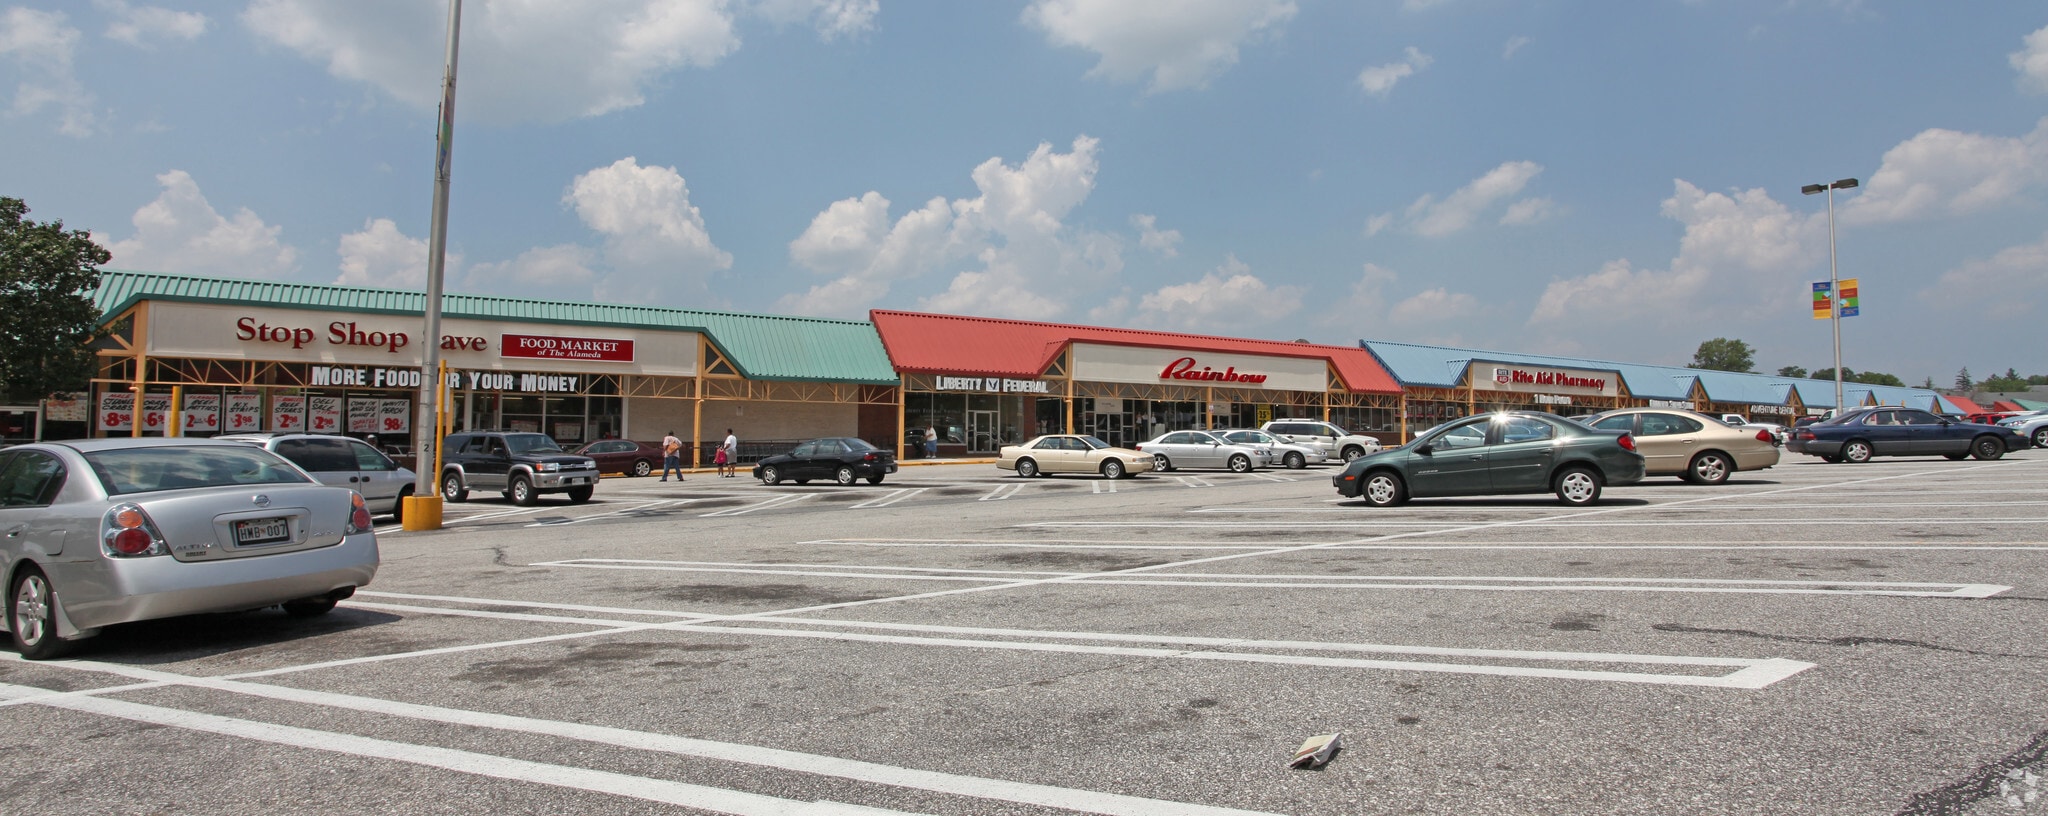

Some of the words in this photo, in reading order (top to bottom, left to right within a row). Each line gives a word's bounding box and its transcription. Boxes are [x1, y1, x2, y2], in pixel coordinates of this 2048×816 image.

[236, 317, 314, 349] Stop
[328, 322, 408, 353] Shop
[440, 334, 488, 351] ave
[519, 338, 556, 349] FOOD
[560, 340, 619, 352] MARKET
[537, 349, 546, 357] of
[567, 350, 601, 358] Alameda
[1159, 357, 1268, 384] Rainbow
[311, 367, 365, 385] MORE
[374, 369, 420, 387] FOOD
[470, 372, 513, 389] YOUR
[521, 374, 577, 392] MONEY
[936, 376, 982, 391] LIBERTY
[1003, 378, 1048, 393] FEDERAL
[1512, 370, 1533, 384] Rite
[1535, 372, 1553, 385] Aid
[1556, 373, 1605, 391] Pharmacy
[1750, 405, 1779, 415] ADVENTURE
[1779, 407, 1795, 415] DENTAL
[424, 444, 429, 452] 2
